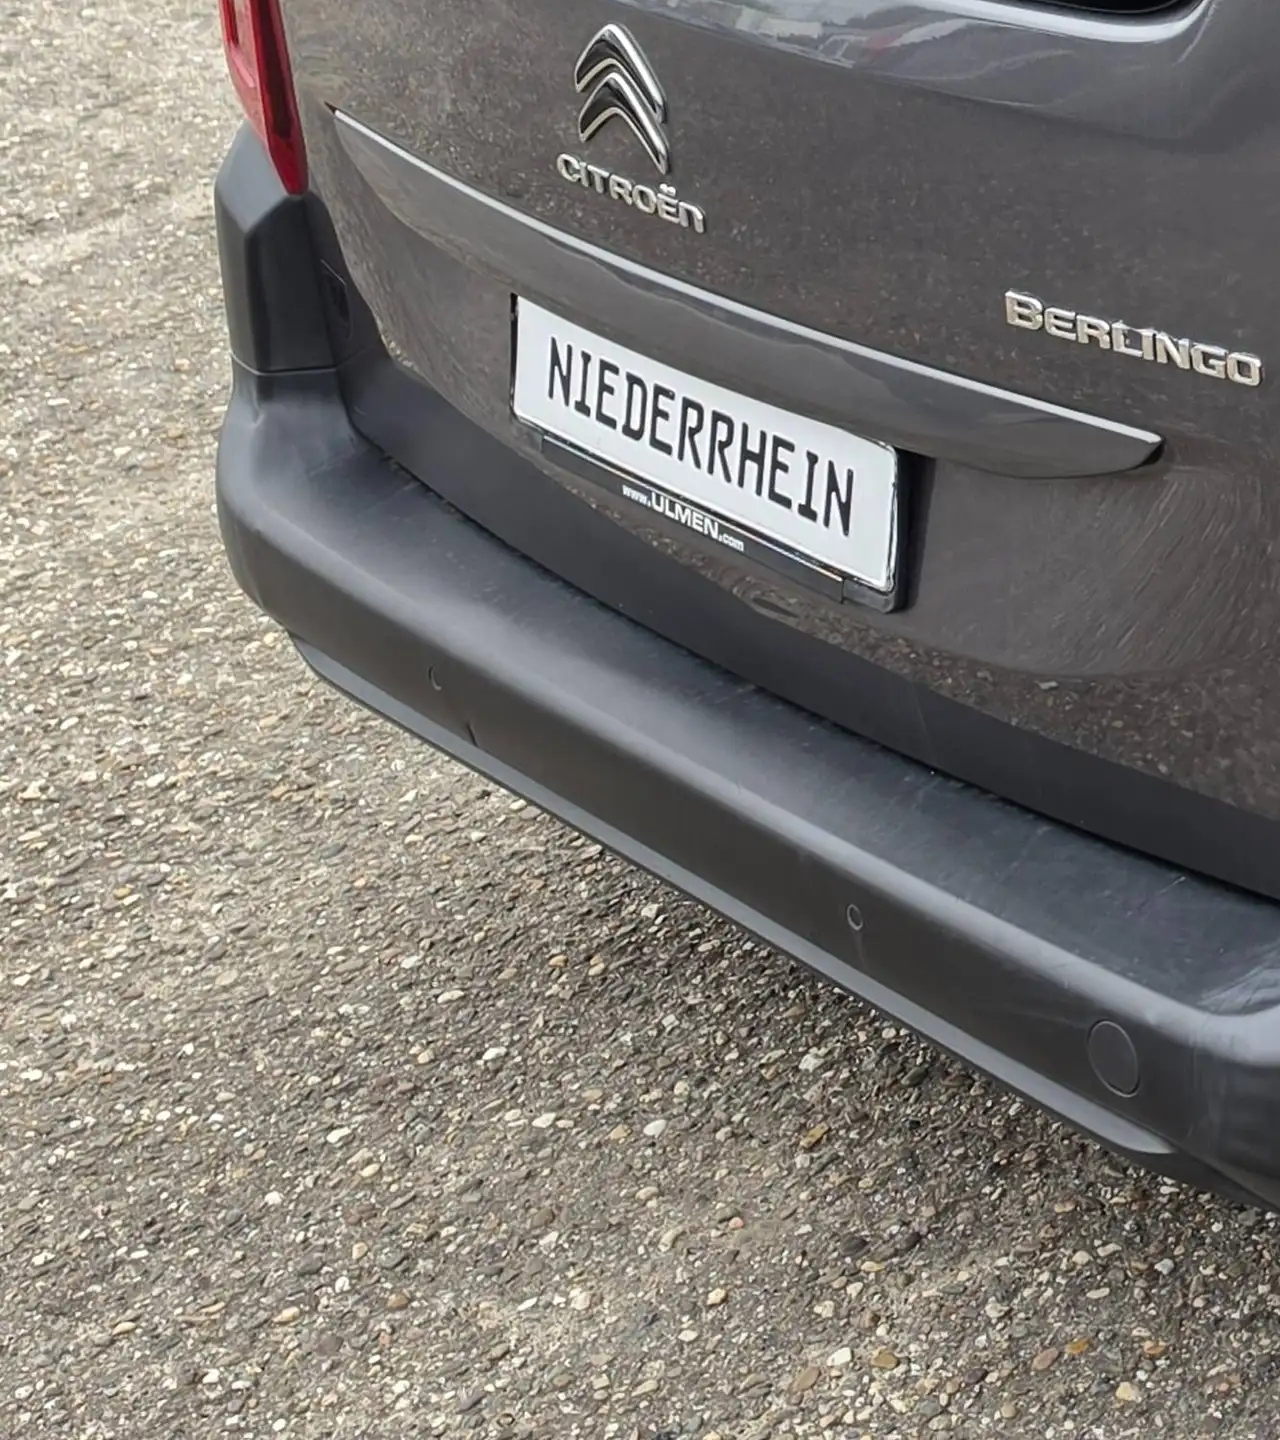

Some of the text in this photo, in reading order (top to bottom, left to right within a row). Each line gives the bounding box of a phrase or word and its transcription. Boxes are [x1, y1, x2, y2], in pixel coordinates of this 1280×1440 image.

[1005, 289, 1263, 387] BERLINGO
[548, 336, 854, 537] NIEDERRHEIN
[622, 485, 745, 552] www.ULMEN.com
